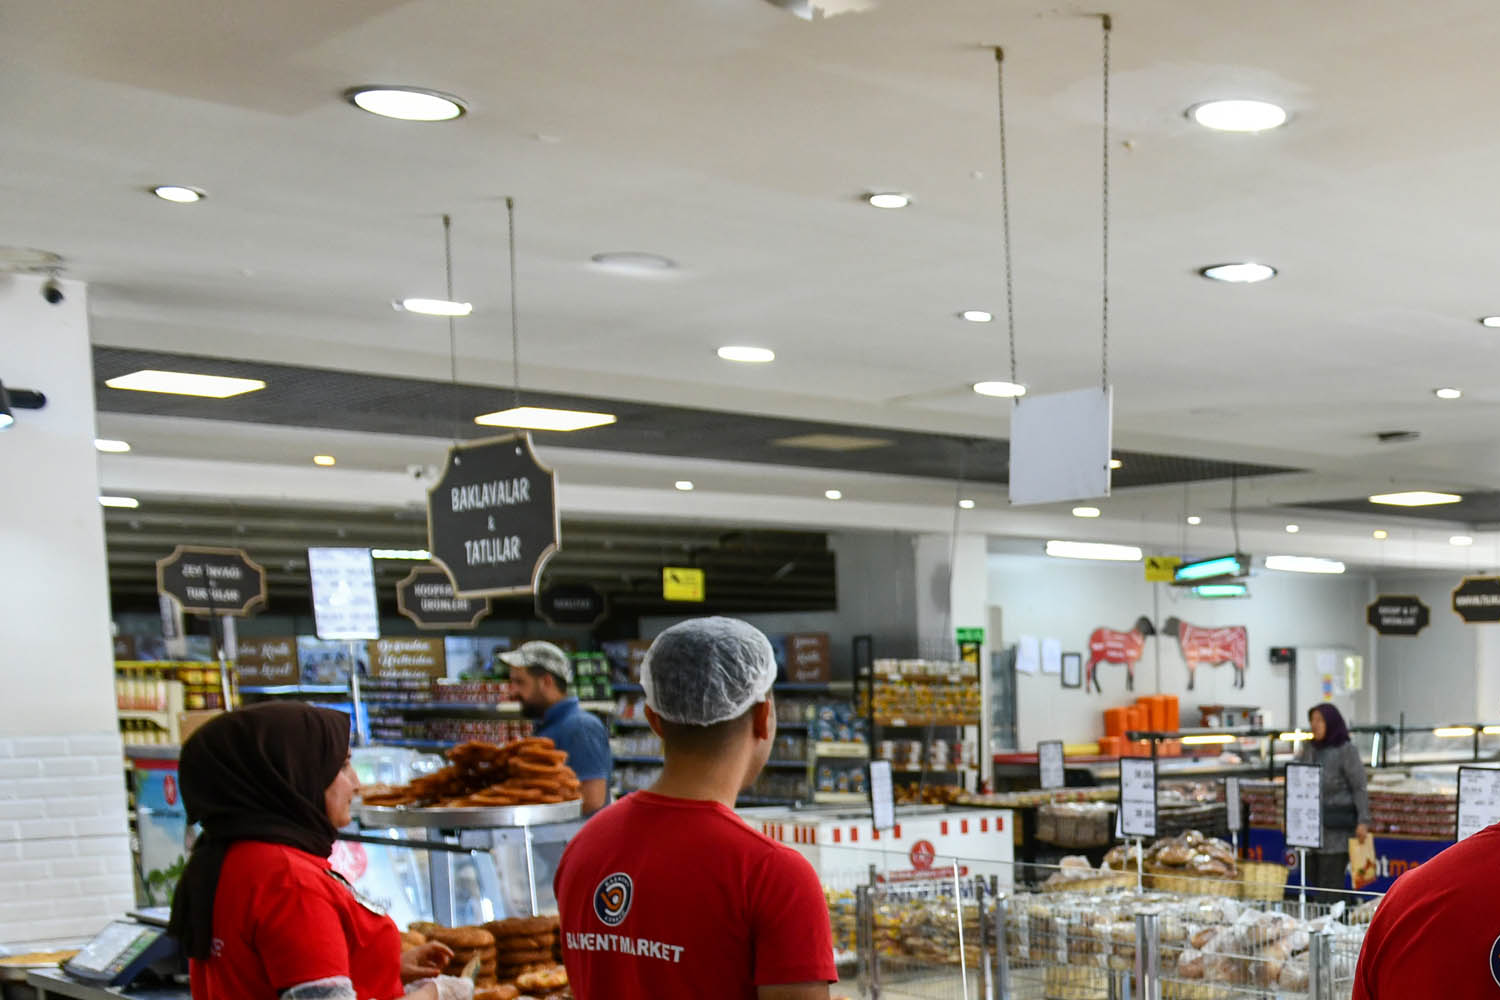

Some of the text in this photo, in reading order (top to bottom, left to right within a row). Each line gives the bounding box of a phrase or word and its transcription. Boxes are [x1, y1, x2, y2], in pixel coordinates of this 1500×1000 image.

[451, 477, 530, 512] BAKLAVALAR
[465, 535, 521, 565] TATLILAR
[620, 935, 684, 963] MARKET
